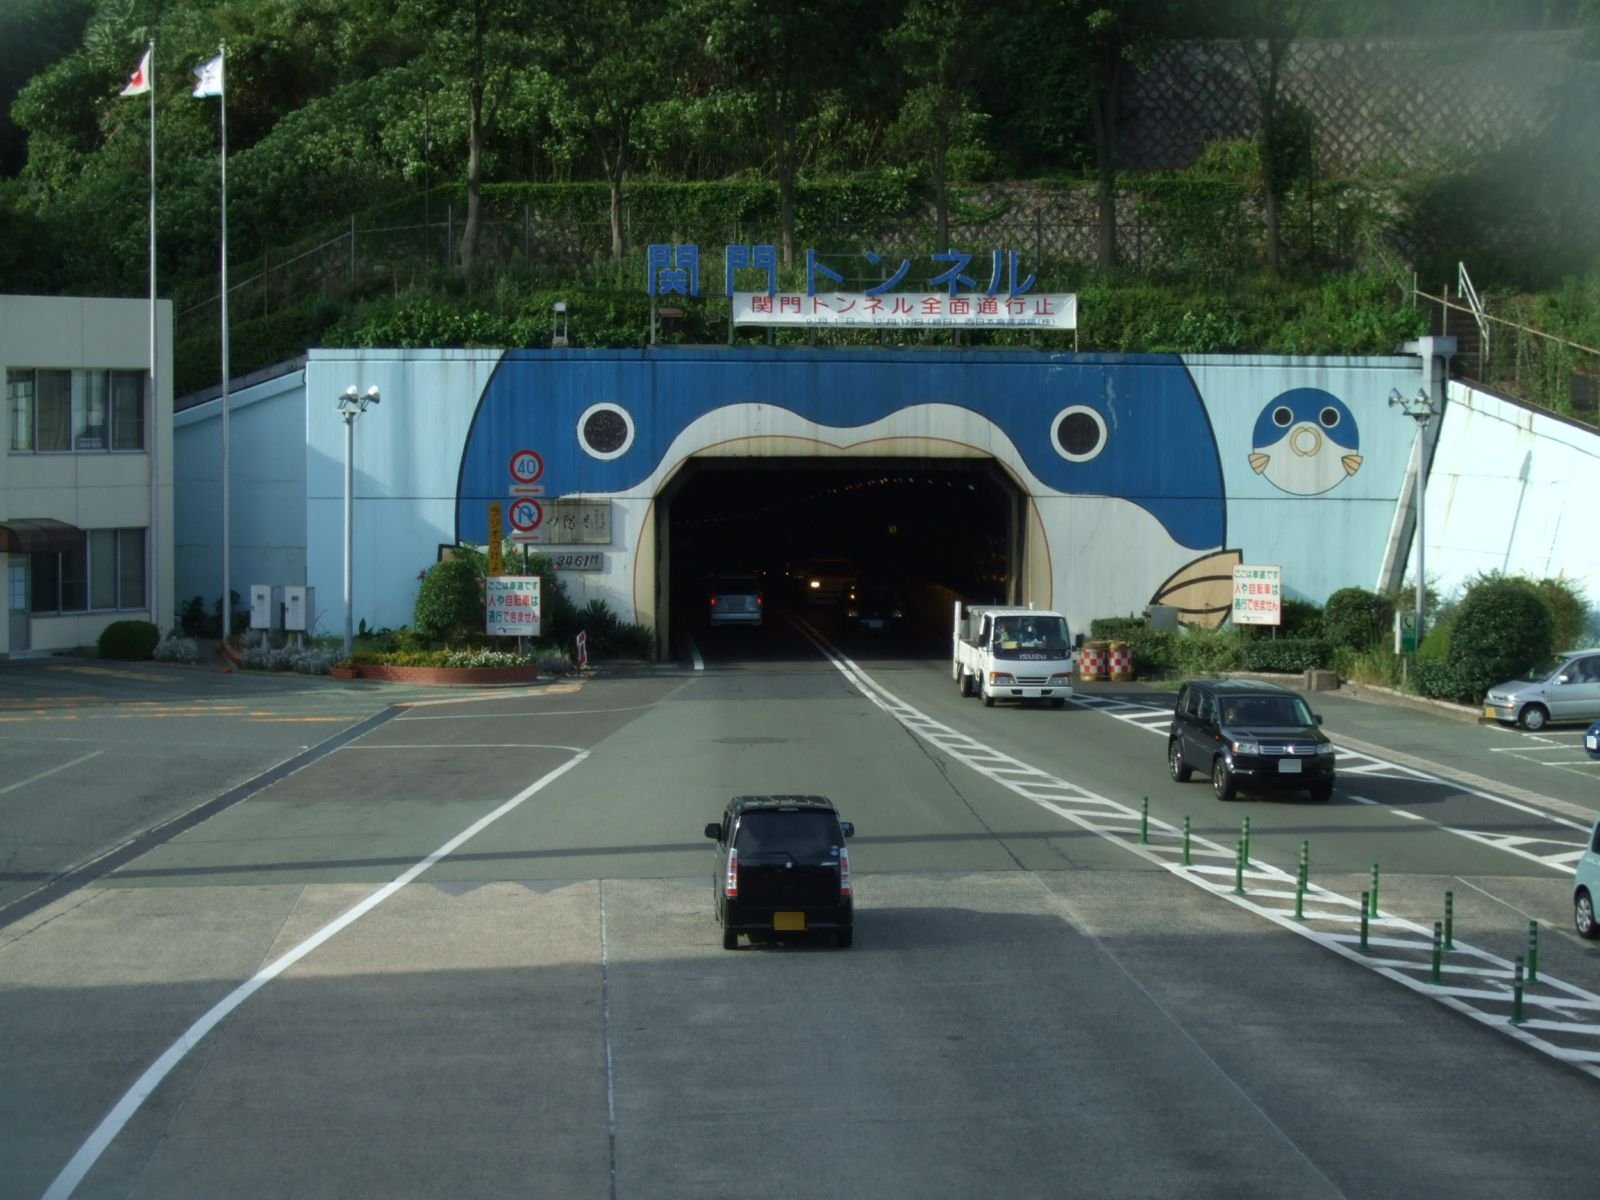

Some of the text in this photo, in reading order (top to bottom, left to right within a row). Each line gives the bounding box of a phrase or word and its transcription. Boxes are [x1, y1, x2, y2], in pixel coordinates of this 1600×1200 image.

[647, 243, 1036, 297] 関門トンネル
[751, 296, 1056, 315] 関門トンネル全面通行止
[517, 459, 536, 475] 40
[1235, 583, 1279, 595] 人や自転車は
[488, 594, 538, 607] 人や自転車は
[1235, 598, 1279, 611] 通行できません
[488, 610, 539, 623] 通行できません
